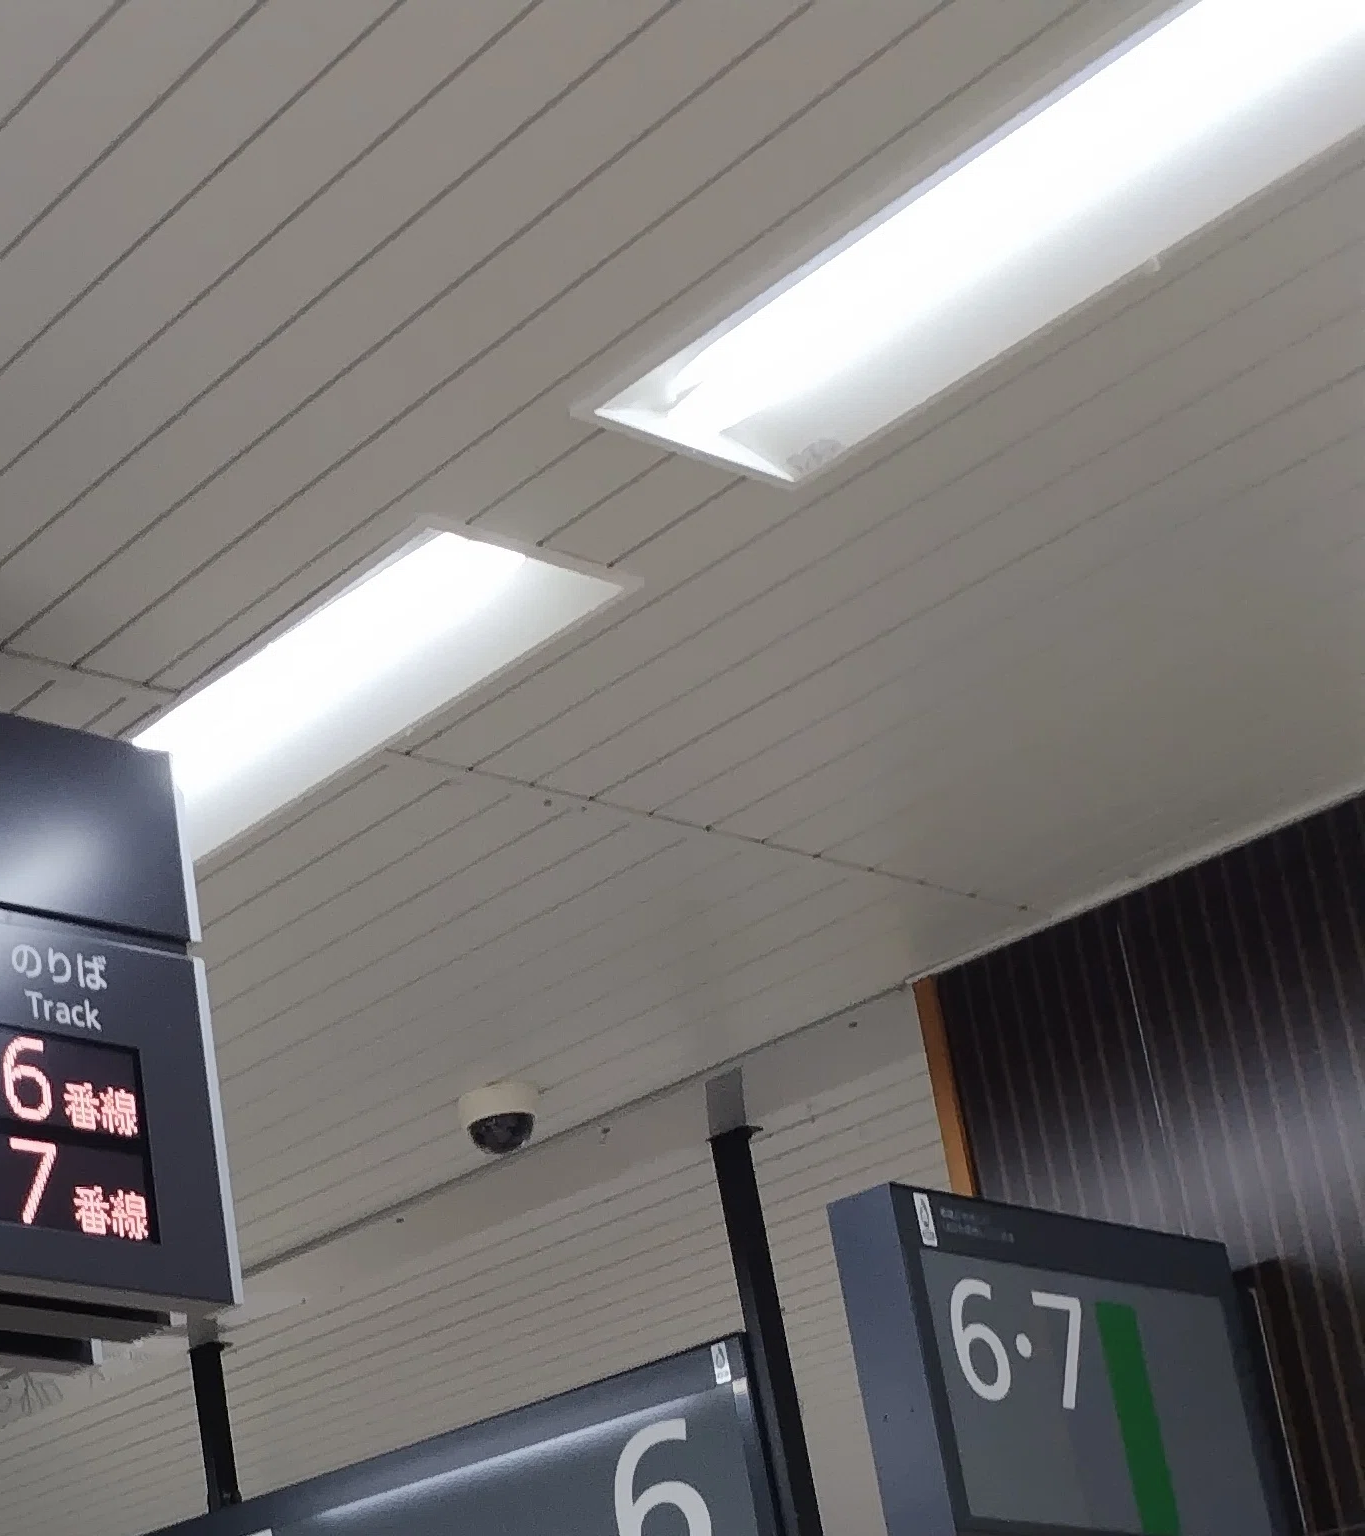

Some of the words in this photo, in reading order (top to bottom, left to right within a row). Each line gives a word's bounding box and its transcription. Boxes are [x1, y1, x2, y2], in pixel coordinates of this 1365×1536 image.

[11, 942, 106, 990] のりば
[24, 989, 102, 1032] Track
